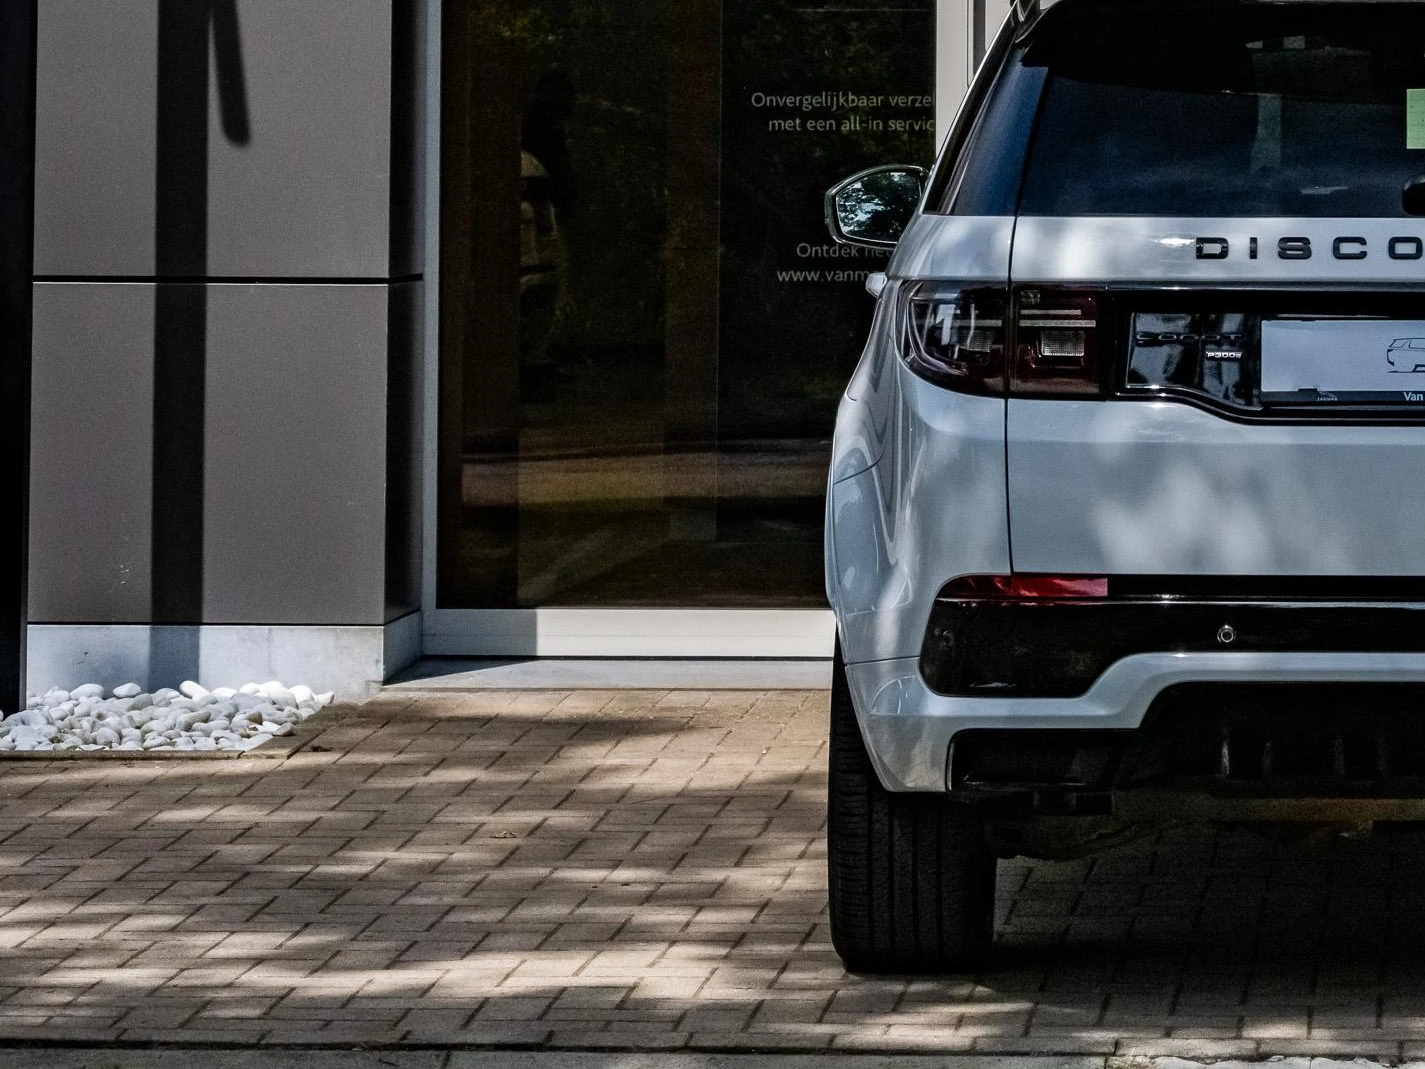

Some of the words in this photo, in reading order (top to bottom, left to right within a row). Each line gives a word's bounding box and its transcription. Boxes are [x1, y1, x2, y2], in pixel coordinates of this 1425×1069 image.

[751, 91, 884, 111] Onvergelijkbaar
[768, 118, 801, 131] met
[806, 119, 836, 131] een
[840, 115, 883, 131] all-in
[796, 242, 860, 258] Ontdek
[1403, 391, 1424, 401] Van
